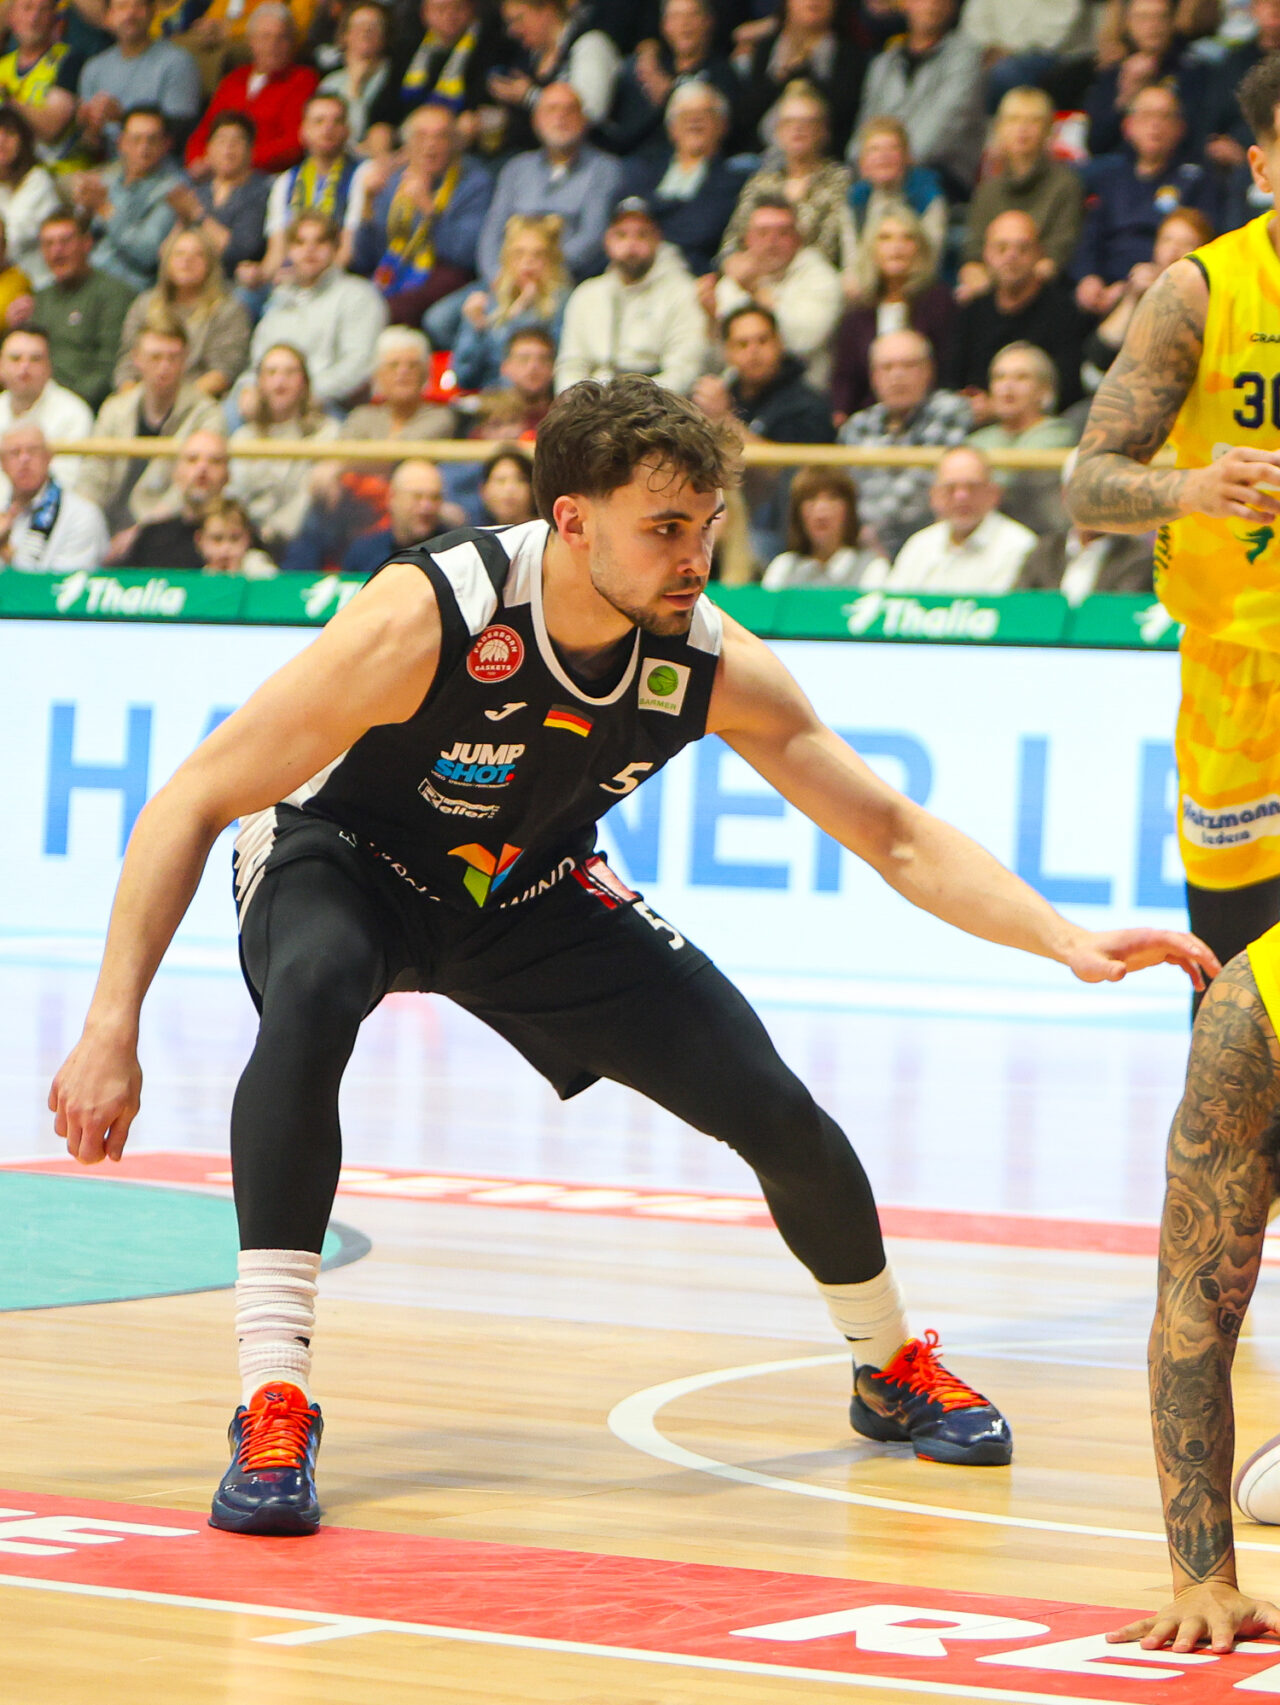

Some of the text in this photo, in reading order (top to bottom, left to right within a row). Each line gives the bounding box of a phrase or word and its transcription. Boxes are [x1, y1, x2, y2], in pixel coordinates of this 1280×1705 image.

[85, 577, 187, 616] Thalia
[883, 597, 1000, 639] Thalia
[474, 664, 512, 672] BASKETS
[639, 697, 677, 711] BARMER
[440, 742, 526, 765] JUMP
[599, 761, 654, 794] 5
[632, 901, 685, 951] 5
